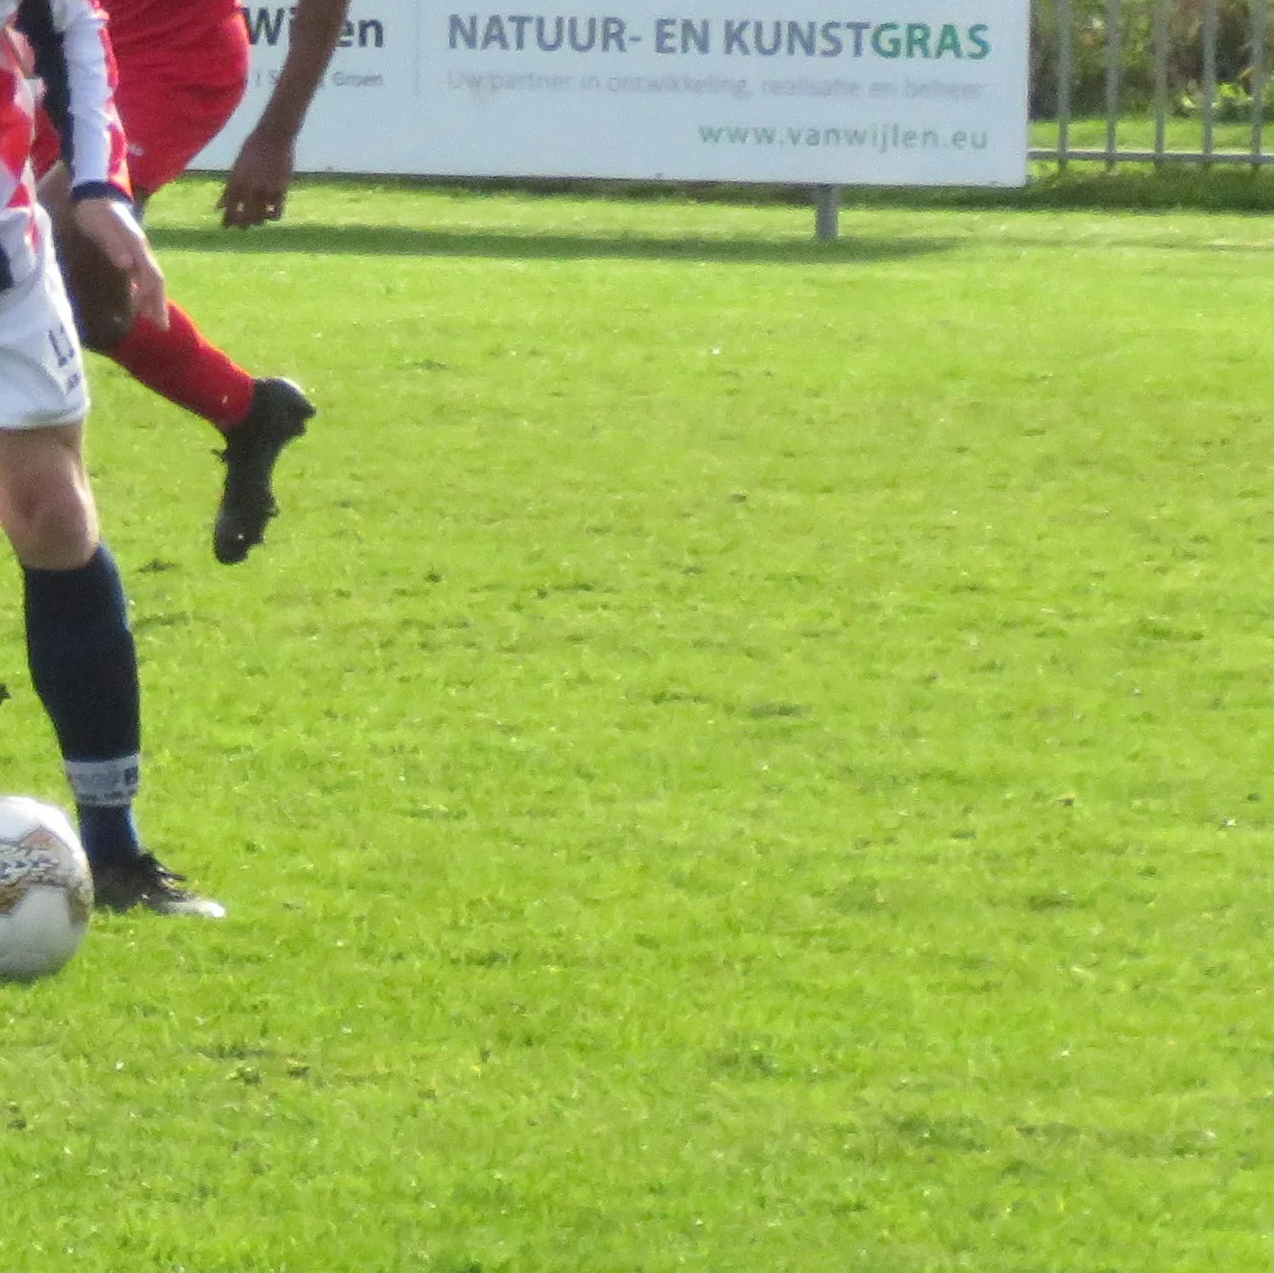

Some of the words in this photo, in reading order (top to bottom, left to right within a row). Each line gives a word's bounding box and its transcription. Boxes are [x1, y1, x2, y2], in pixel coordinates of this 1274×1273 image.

[448, 13, 643, 54] NATUUR-
[654, 17, 710, 55] EN
[722, 20, 992, 61] KUNSTGRAS
[700, 122, 989, 154] www.vanwijlen.eu
